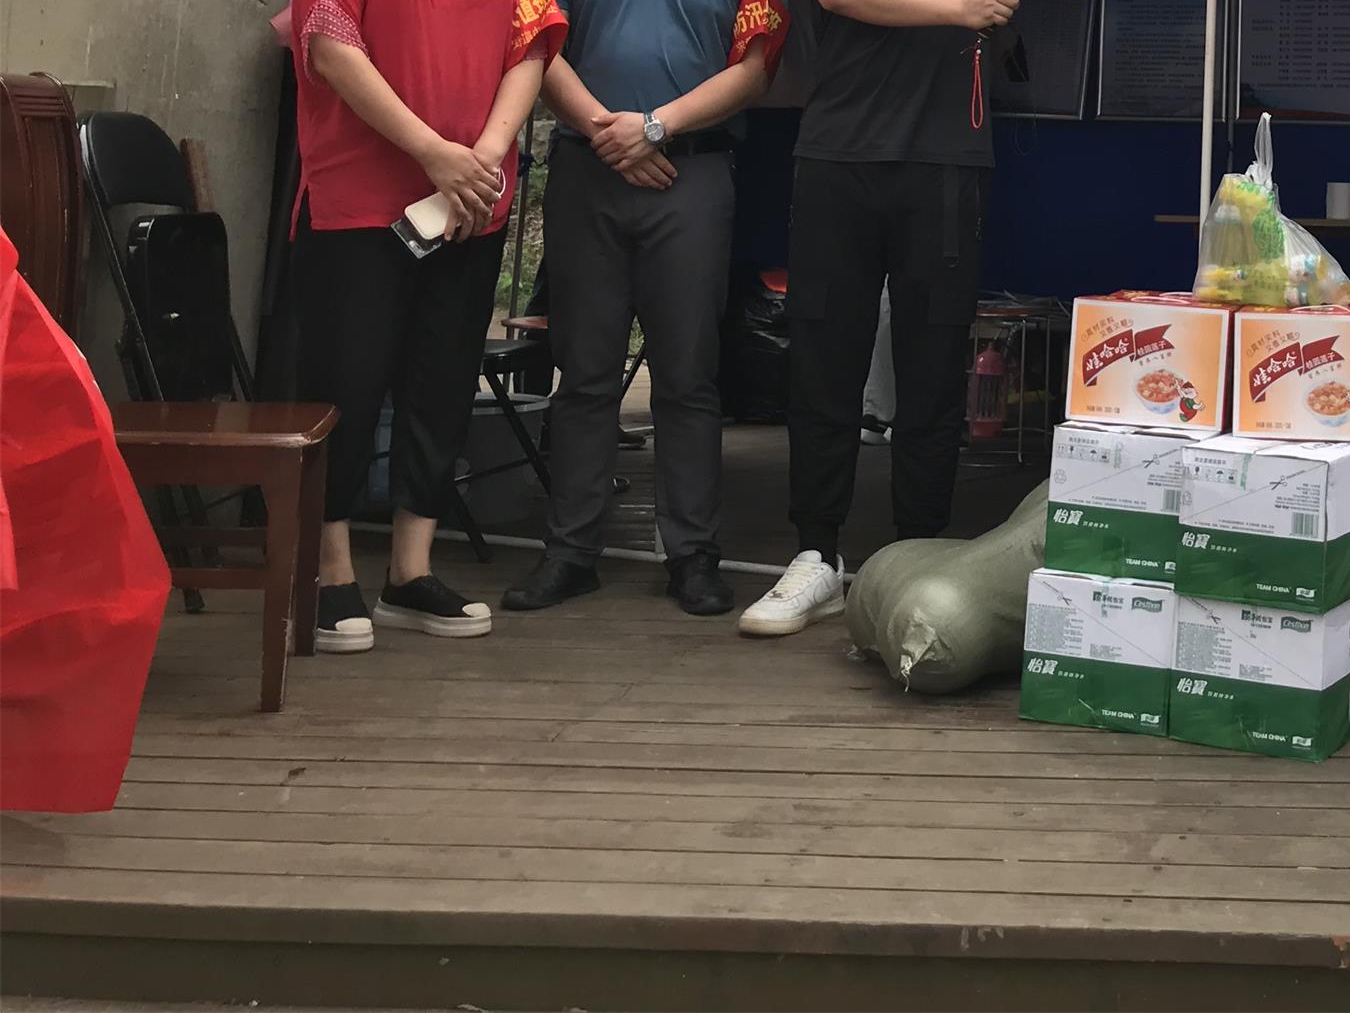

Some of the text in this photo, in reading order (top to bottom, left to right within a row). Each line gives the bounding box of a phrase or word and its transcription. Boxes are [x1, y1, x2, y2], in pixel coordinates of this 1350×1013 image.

[1086, 339, 1130, 372] 娃哈哈
[1253, 353, 1298, 387] 娃哈哈
[1126, 558, 1141, 566] TEAM
[1141, 560, 1159, 568] CHINA
[1256, 583, 1272, 591] TEAM
[1272, 585, 1290, 594] CHINA
[1101, 709, 1117, 717] TEAM
[1117, 711, 1135, 720] CHINA
[1252, 732, 1286, 742] TEAM CHINA
